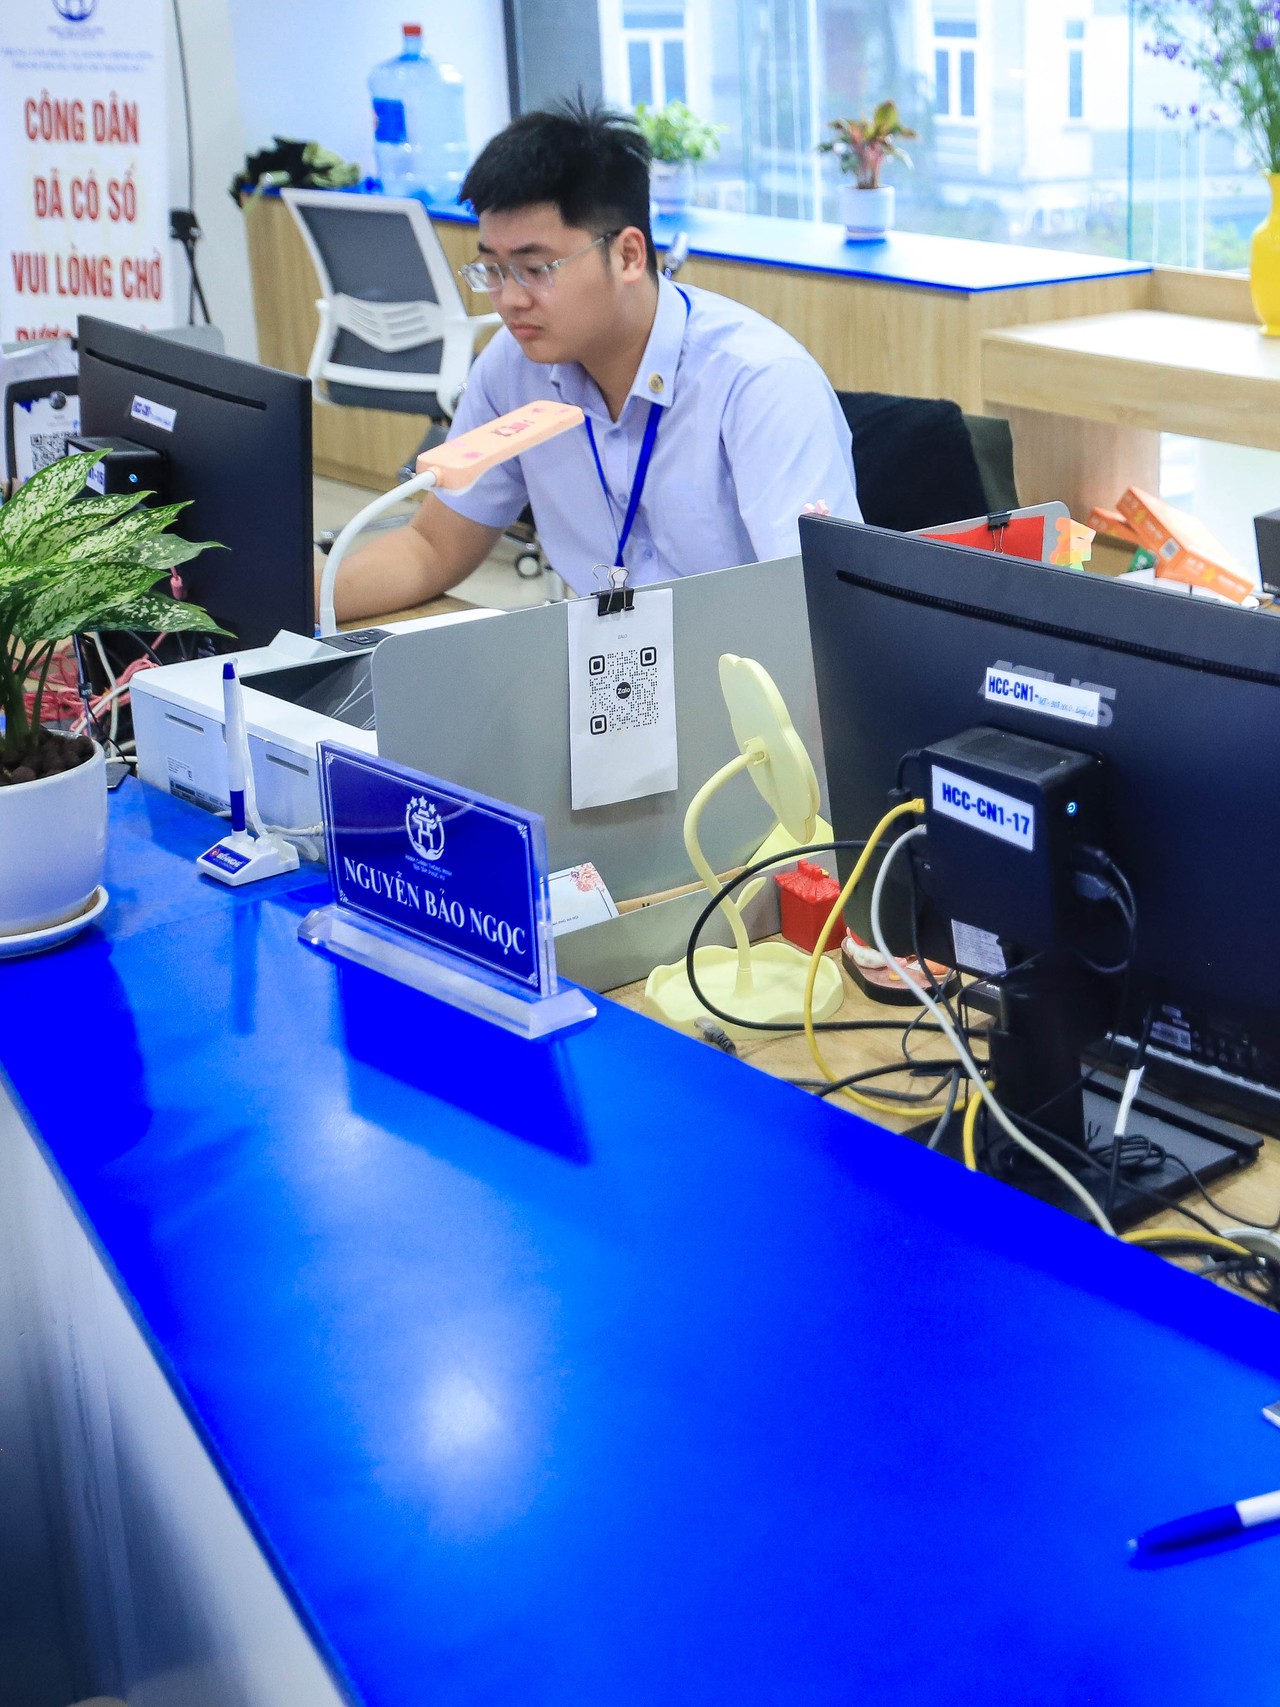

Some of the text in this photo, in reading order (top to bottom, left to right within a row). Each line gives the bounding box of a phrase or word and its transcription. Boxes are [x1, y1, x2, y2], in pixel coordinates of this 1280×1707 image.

[25, 88, 140, 144] CÔNG DÂN
[34, 164, 138, 223] ĐÃ CÓ SỐ
[11, 244, 164, 302] VUI LÒNG CHỜ
[617, 687, 631, 695] Zalo
[941, 782, 1030, 836] HCC-CN1-17
[343, 856, 420, 909] NGUYỄN
[424, 887, 466, 929] BẢO
[469, 906, 527, 955] NGỌC
